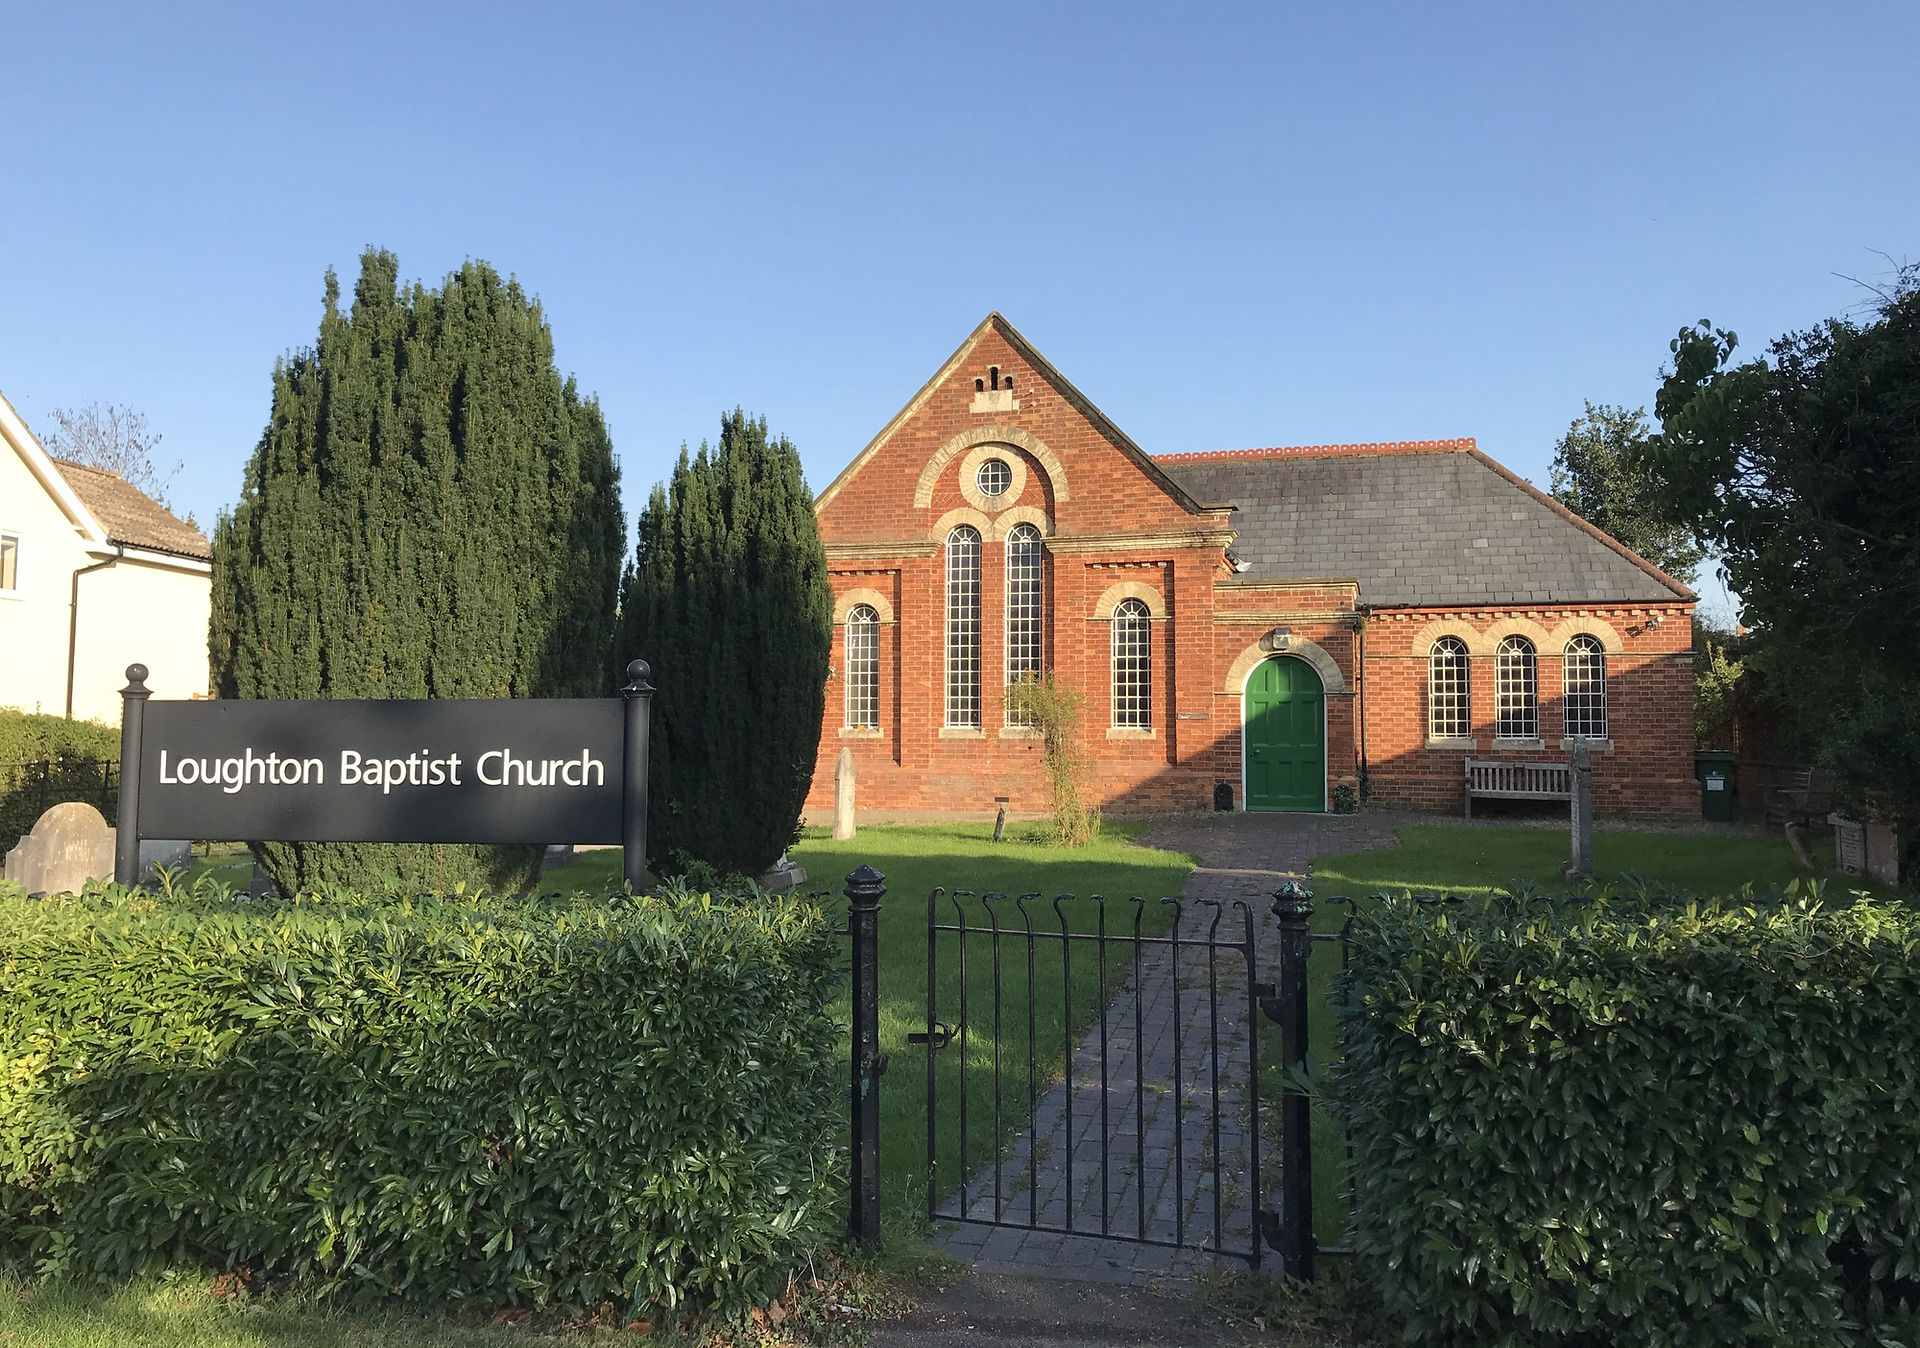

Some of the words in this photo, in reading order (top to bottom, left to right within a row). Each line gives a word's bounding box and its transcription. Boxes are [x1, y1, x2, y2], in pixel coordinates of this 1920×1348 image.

[159, 747, 324, 794] Loughton
[340, 748, 462, 795] Baptist
[476, 748, 605, 786] Church
